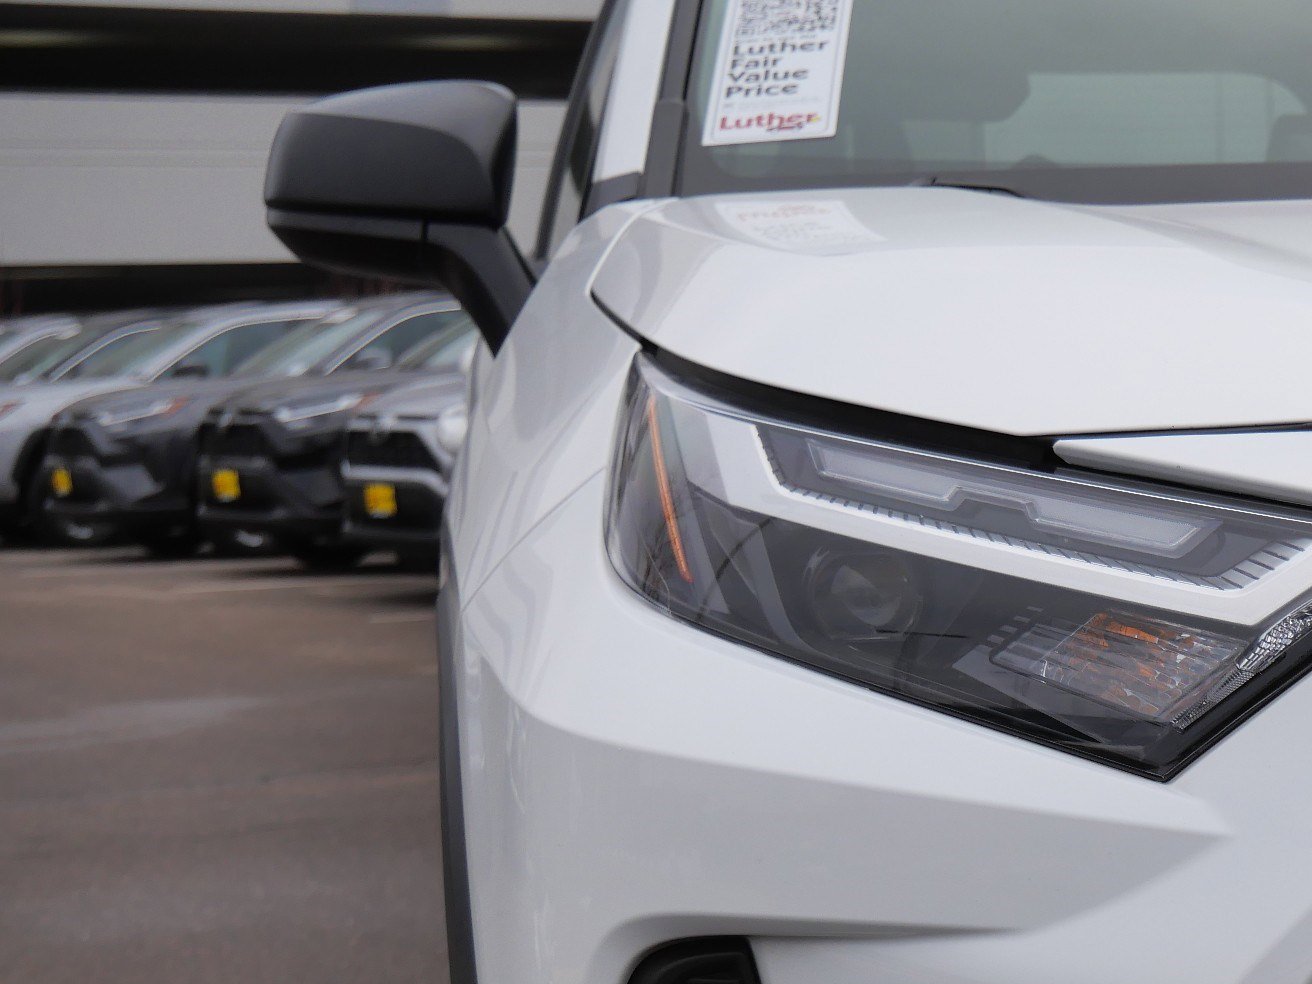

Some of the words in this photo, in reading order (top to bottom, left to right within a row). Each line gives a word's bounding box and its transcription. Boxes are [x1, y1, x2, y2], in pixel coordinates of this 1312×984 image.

[734, 40, 828, 56] Luther
[731, 56, 781, 70] Fair
[728, 69, 810, 83] Value
[725, 84, 798, 98] Price
[719, 112, 819, 130] Luther
